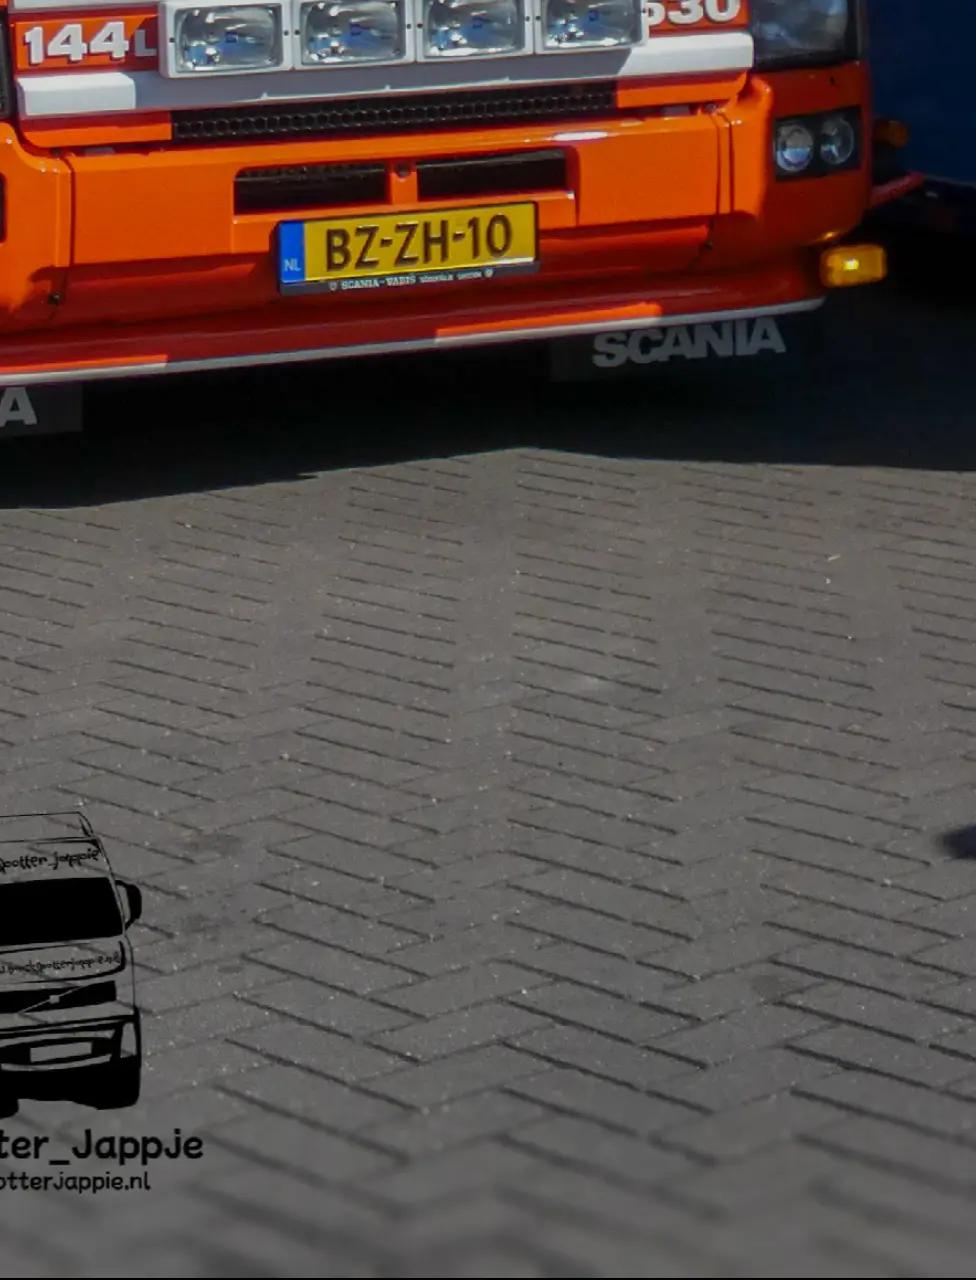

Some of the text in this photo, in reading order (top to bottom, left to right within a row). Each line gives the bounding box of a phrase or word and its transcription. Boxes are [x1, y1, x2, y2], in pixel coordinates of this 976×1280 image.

[284, 258, 302, 272] NL
[326, 213, 512, 272] BZ-ZH-10
[592, 317, 786, 368] SCANIA
